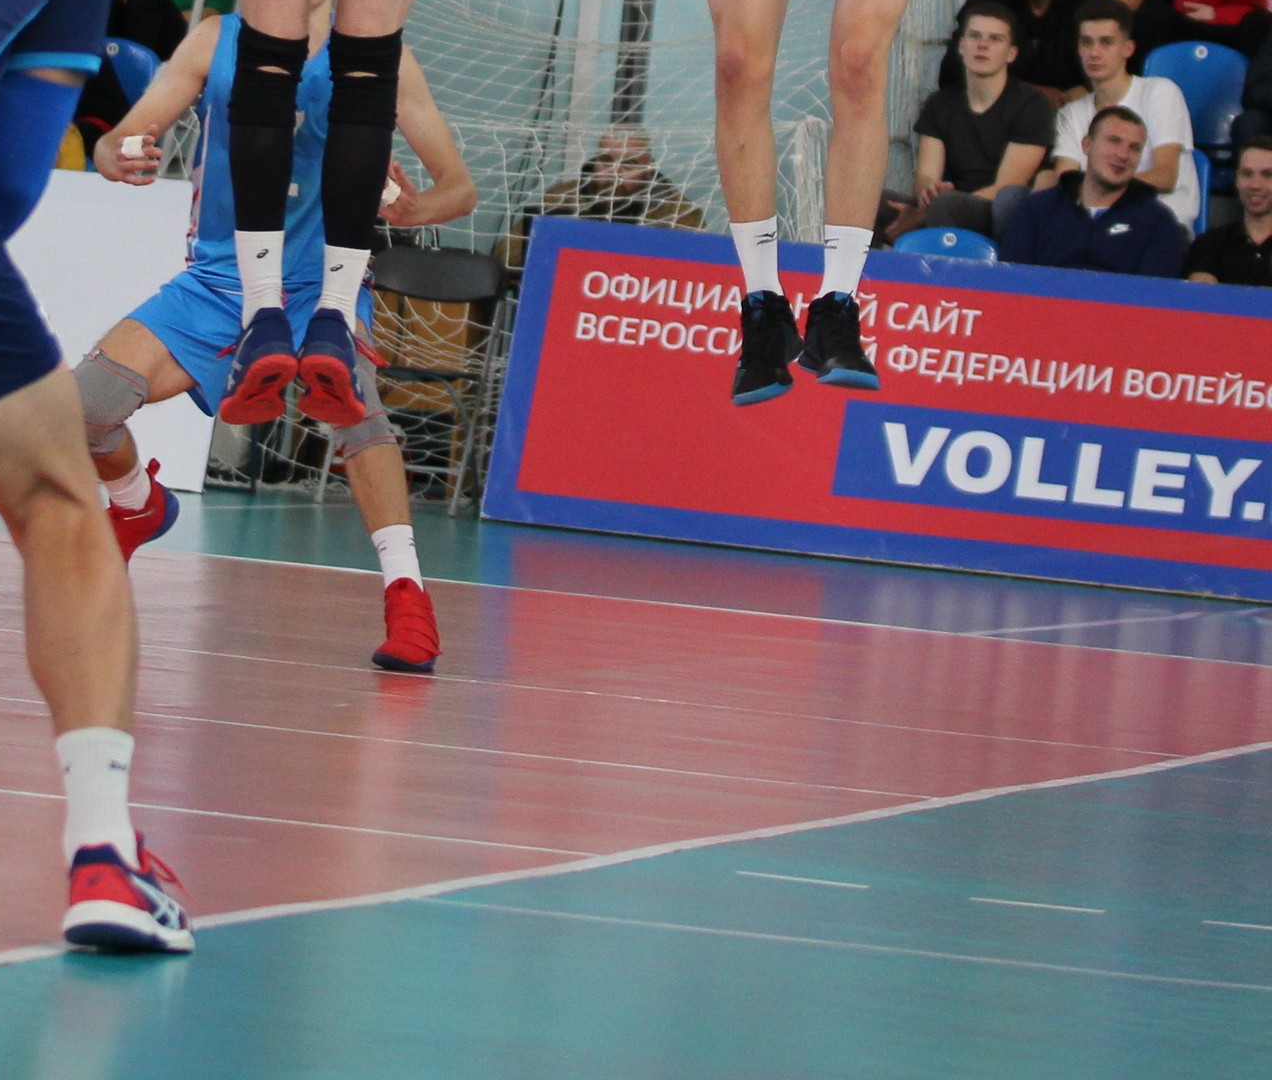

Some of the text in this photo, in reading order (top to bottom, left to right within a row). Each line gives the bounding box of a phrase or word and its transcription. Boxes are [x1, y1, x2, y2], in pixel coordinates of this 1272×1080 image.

[886, 299, 983, 337] САЙТ
[886, 344, 1114, 394] ФЕДЕРАЦИИ
[884, 421, 1272, 522] VOLLEY.
